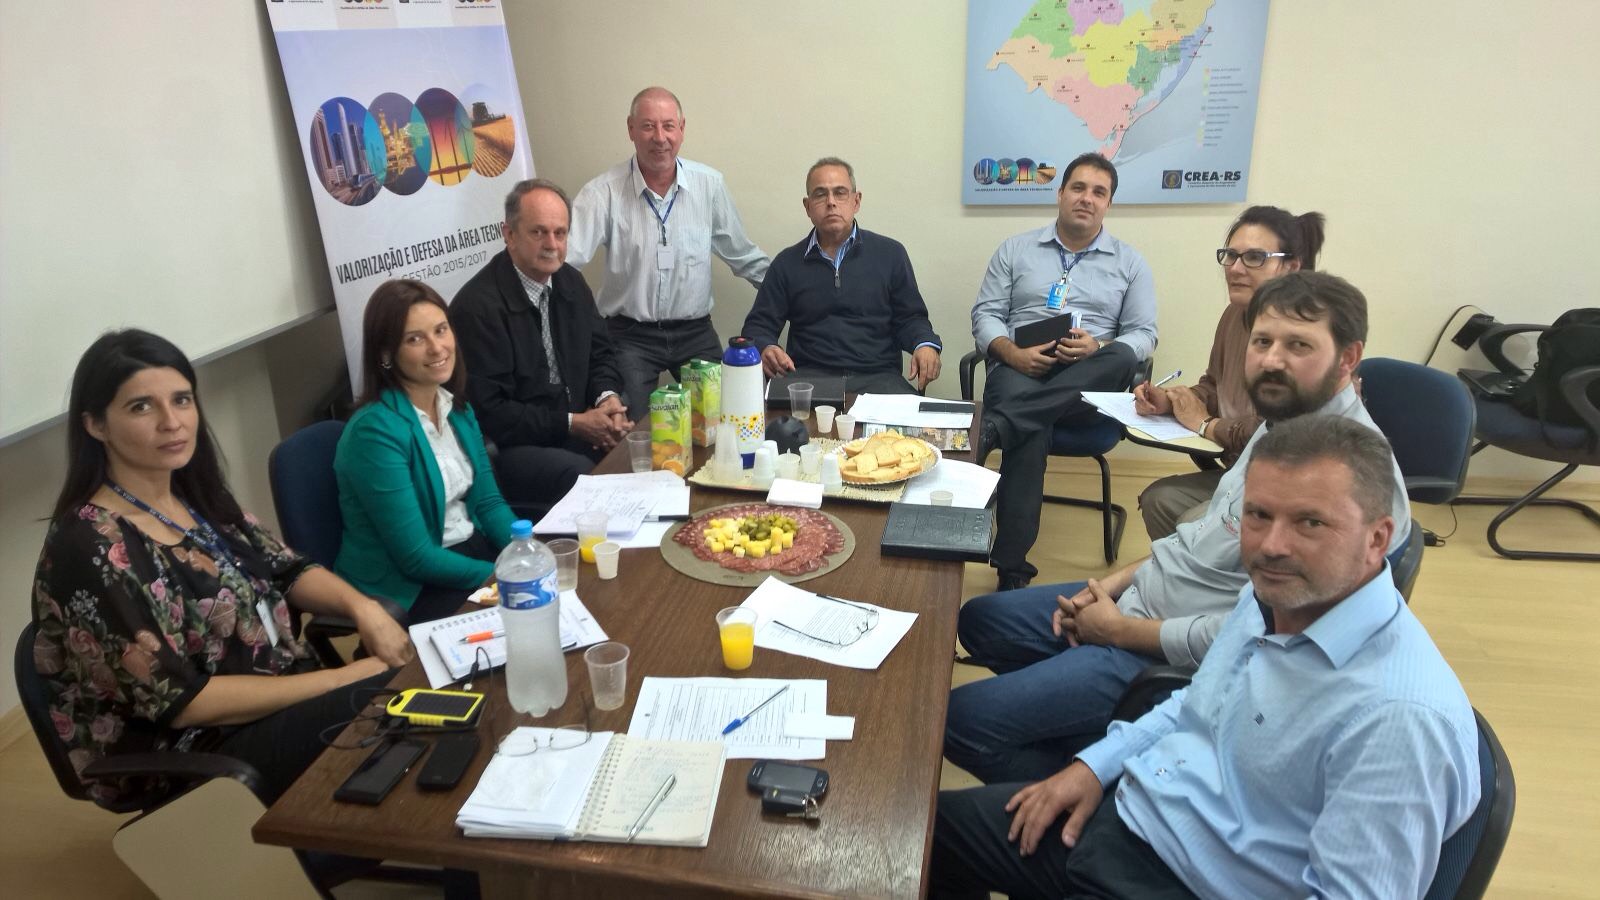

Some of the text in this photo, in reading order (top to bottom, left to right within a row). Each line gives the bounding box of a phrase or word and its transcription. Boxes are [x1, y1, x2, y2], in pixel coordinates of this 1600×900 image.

[1184, 171, 1241, 182] CREA-RS
[336, 247, 404, 285] VALORIZAÇÃO
[403, 247, 411, 265] E
[411, 238, 445, 263] DEFESA
[444, 234, 458, 253] DA
[458, 228, 481, 250] ÁREA
[443, 250, 488, 273] 2015/2017
